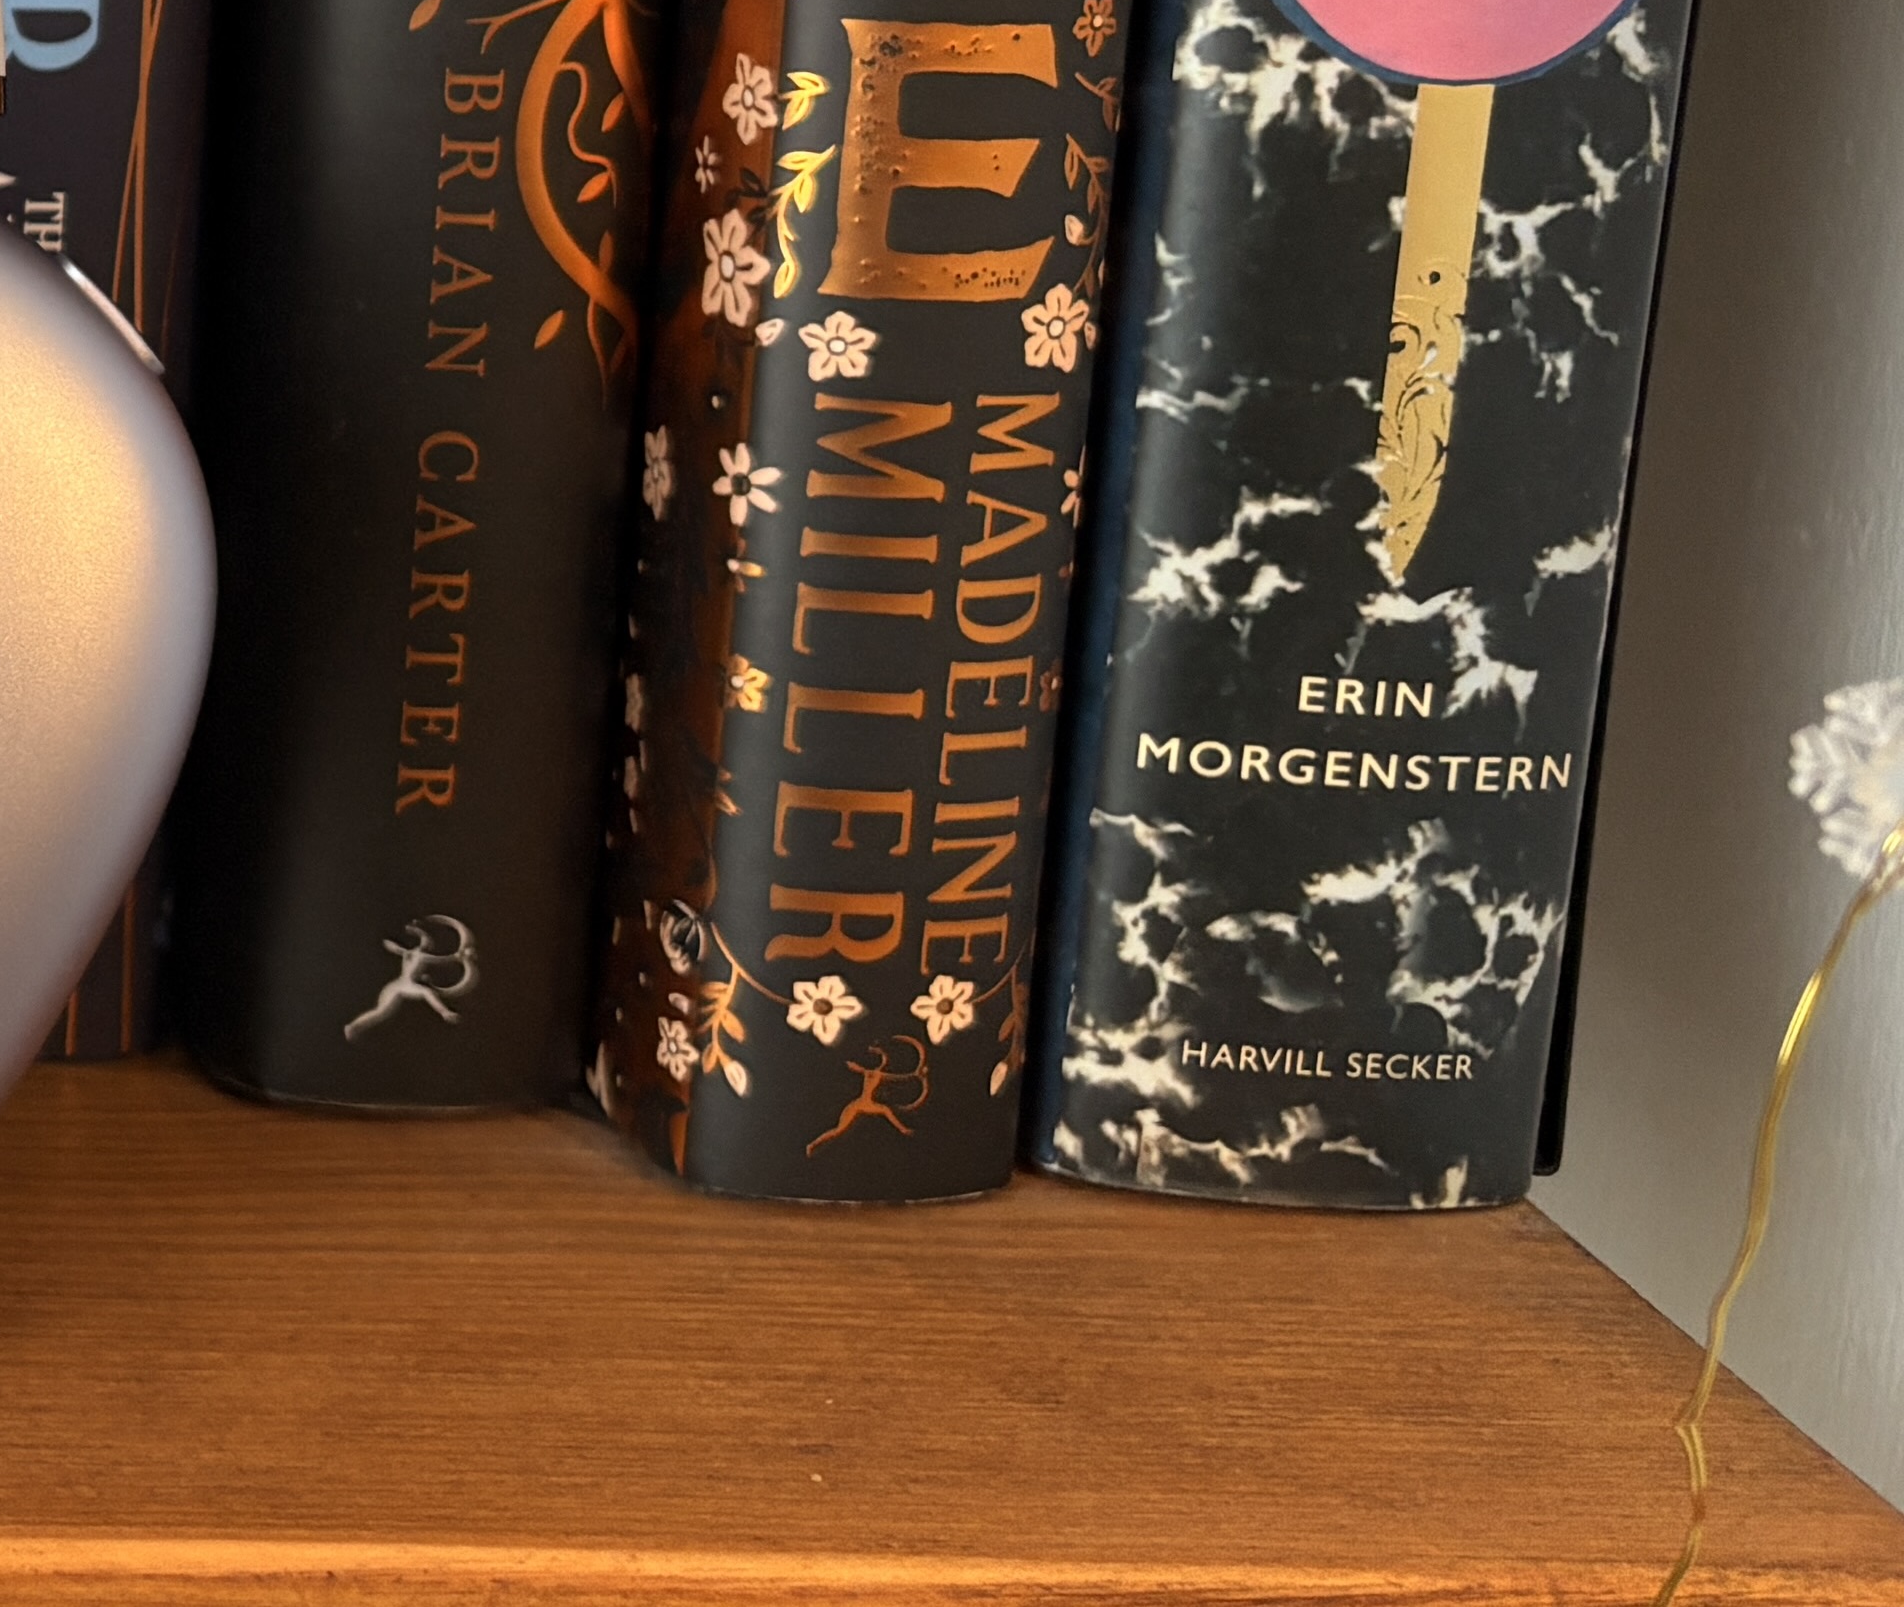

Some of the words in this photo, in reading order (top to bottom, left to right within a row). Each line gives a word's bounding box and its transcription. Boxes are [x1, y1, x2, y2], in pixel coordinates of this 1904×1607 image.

[423, 64, 508, 380] BRIAN
[394, 430, 482, 816] CARTER
[764, 391, 954, 965] MILLER
[920, 391, 1061, 975] MADELINE
[1136, 732, 1572, 792] MORGENSTERN
[1297, 676, 1435, 718] ERIN
[1180, 1039, 1333, 1078] HARVILL
[1345, 1052, 1474, 1082] SECKER
